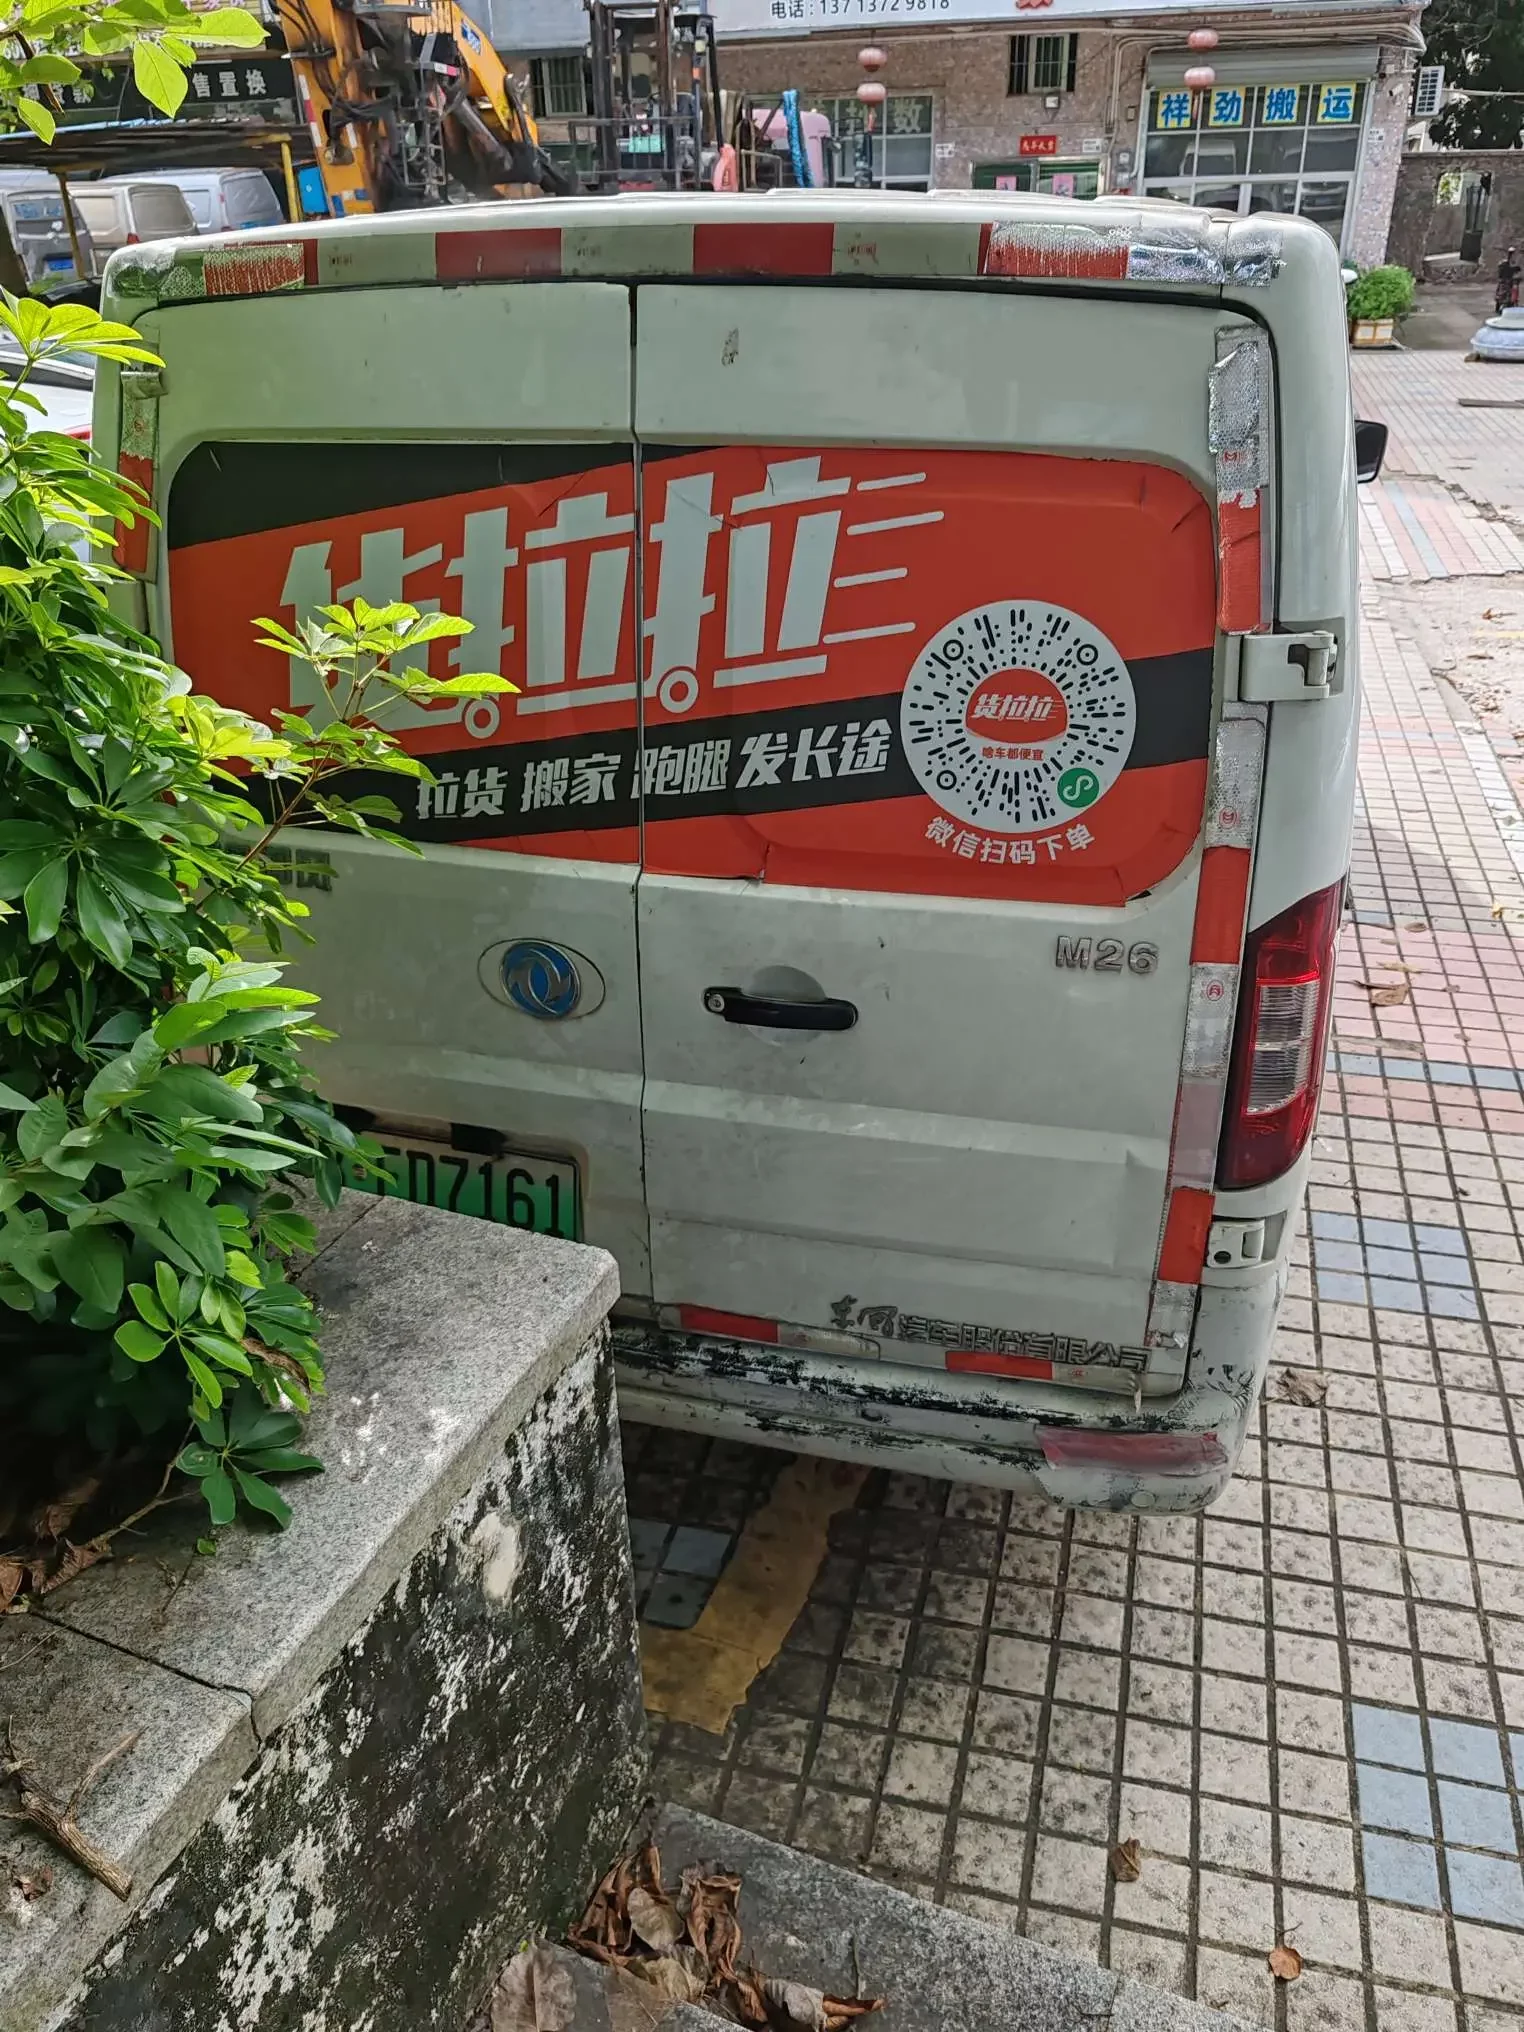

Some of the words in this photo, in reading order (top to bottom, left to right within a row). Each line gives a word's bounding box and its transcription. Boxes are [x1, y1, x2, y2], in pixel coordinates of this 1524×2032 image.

[1161, 87, 1353, 127] 祥劲搬运
[971, 693, 1055, 721] 货拉拉
[416, 763, 509, 821] 拉货
[520, 752, 621, 813] 搬家
[630, 738, 732, 800] 跑腿
[735, 718, 893, 789] 发长途
[924, 815, 1095, 865] 微信扫码下单
[1055, 935, 1160, 975] M26
